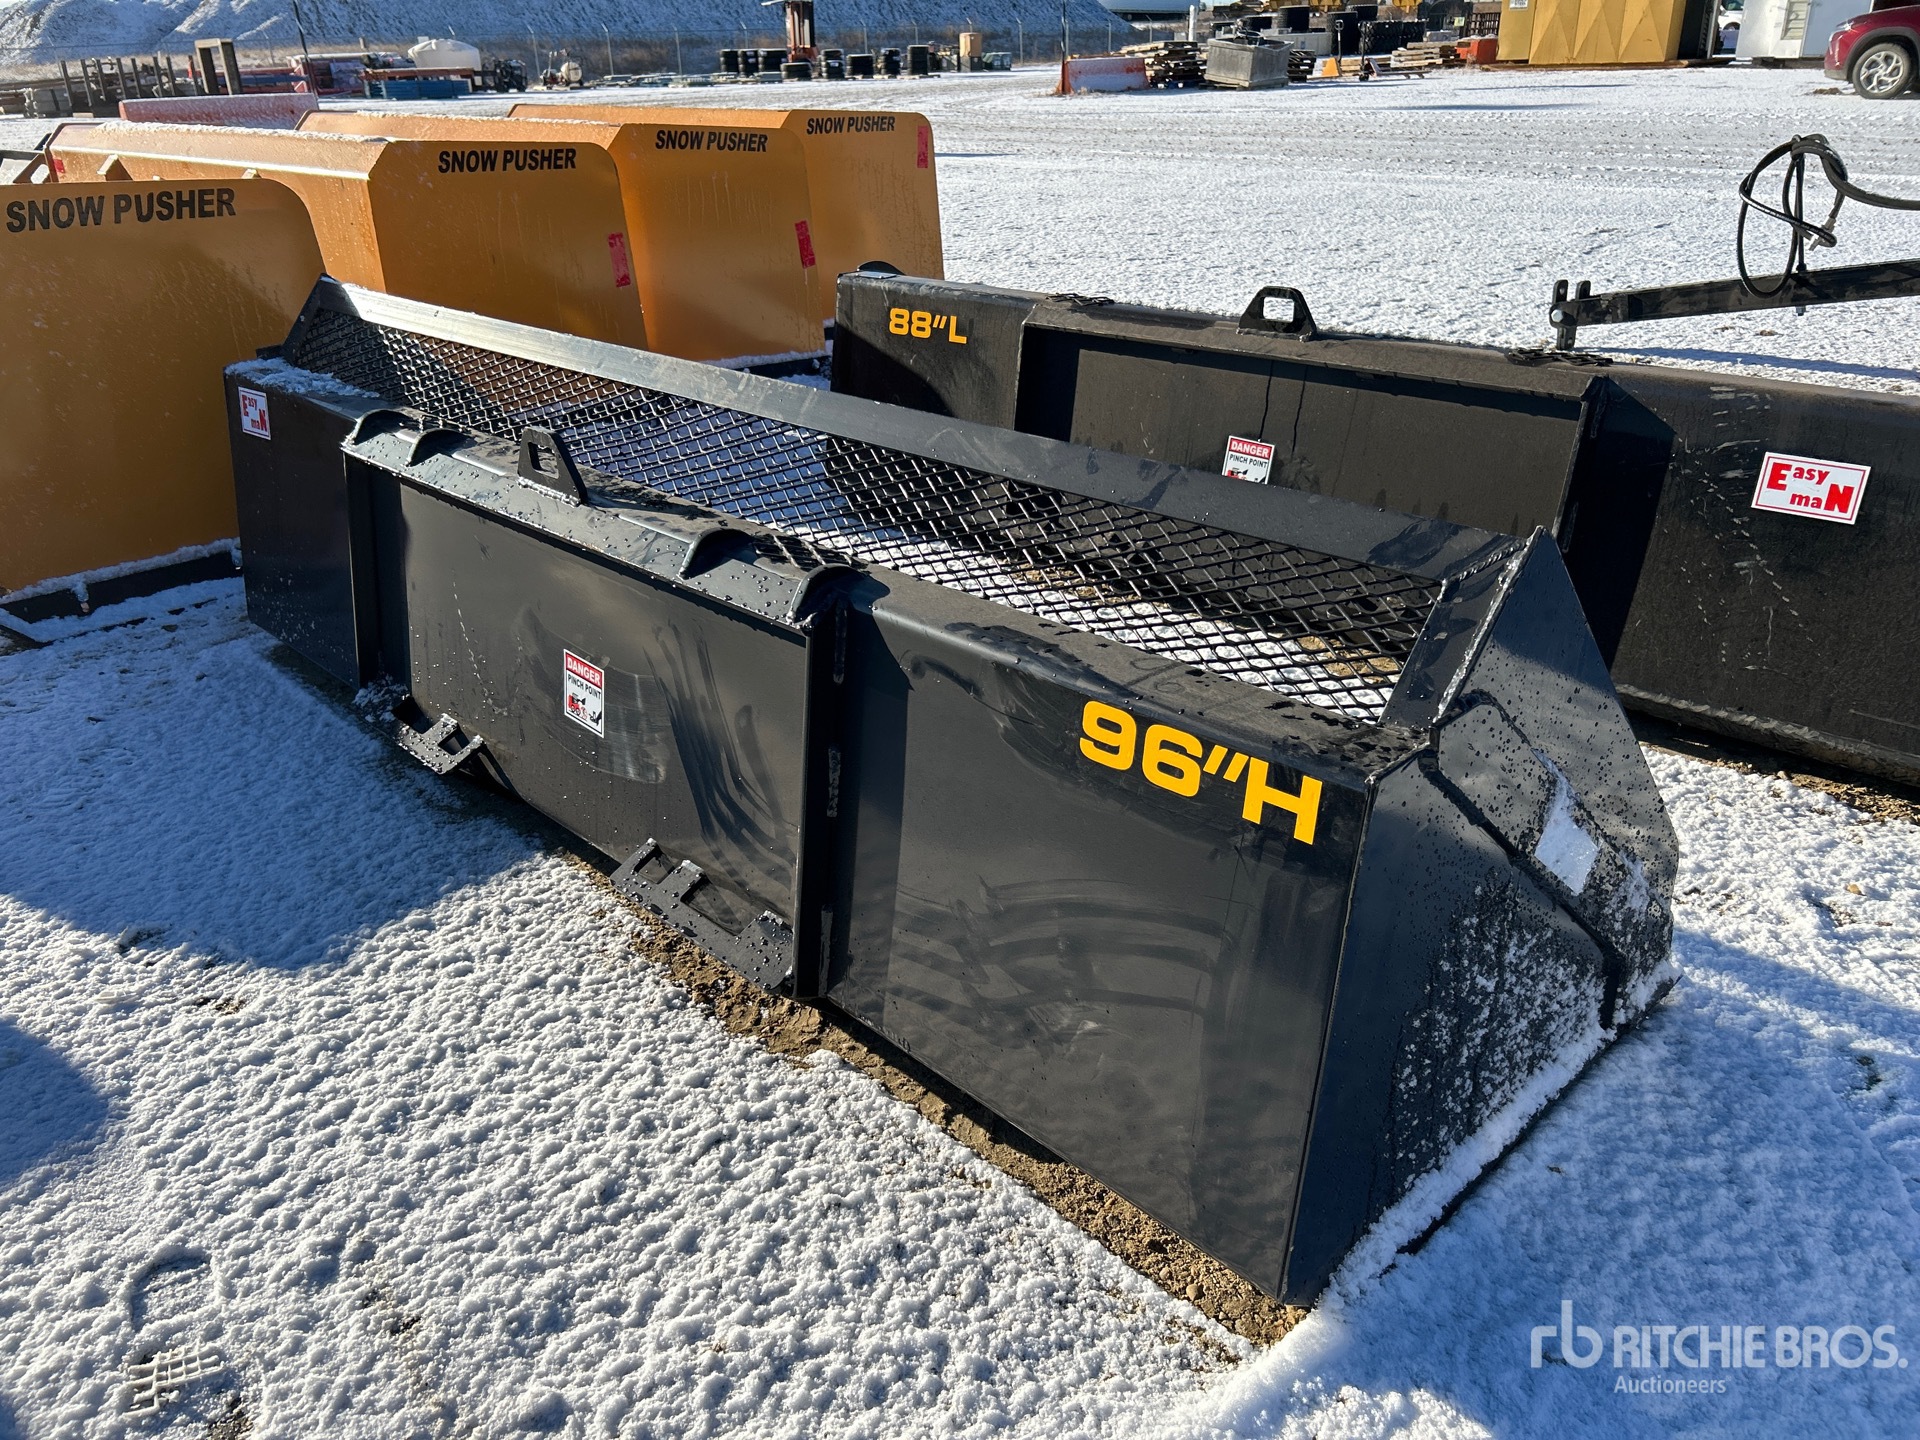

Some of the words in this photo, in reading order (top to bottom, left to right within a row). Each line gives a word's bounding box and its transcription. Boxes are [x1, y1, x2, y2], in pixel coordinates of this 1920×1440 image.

[806, 117, 845, 135] SNOW
[847, 116, 895, 133] PUSHER
[655, 130, 704, 150] SNOW
[706, 131, 768, 152] PUSHER
[438, 150, 498, 174] SNOW
[502, 148, 577, 172] PUSHER
[6, 195, 105, 233] SNOW
[113, 187, 236, 224] PUSHER
[889, 307, 967, 345] 88"L
[1229, 453, 1248, 464] PINCH
[1249, 459, 1268, 469] POINT
[1230, 441, 1269, 458] DANGER
[1766, 462, 1830, 491] Easy
[1789, 483, 1855, 514] maN
[567, 657, 601, 686] DANGER
[567, 673, 584, 691] PINCH
[585, 683, 601, 700] POINT
[1079, 700, 1323, 846] 96"H
